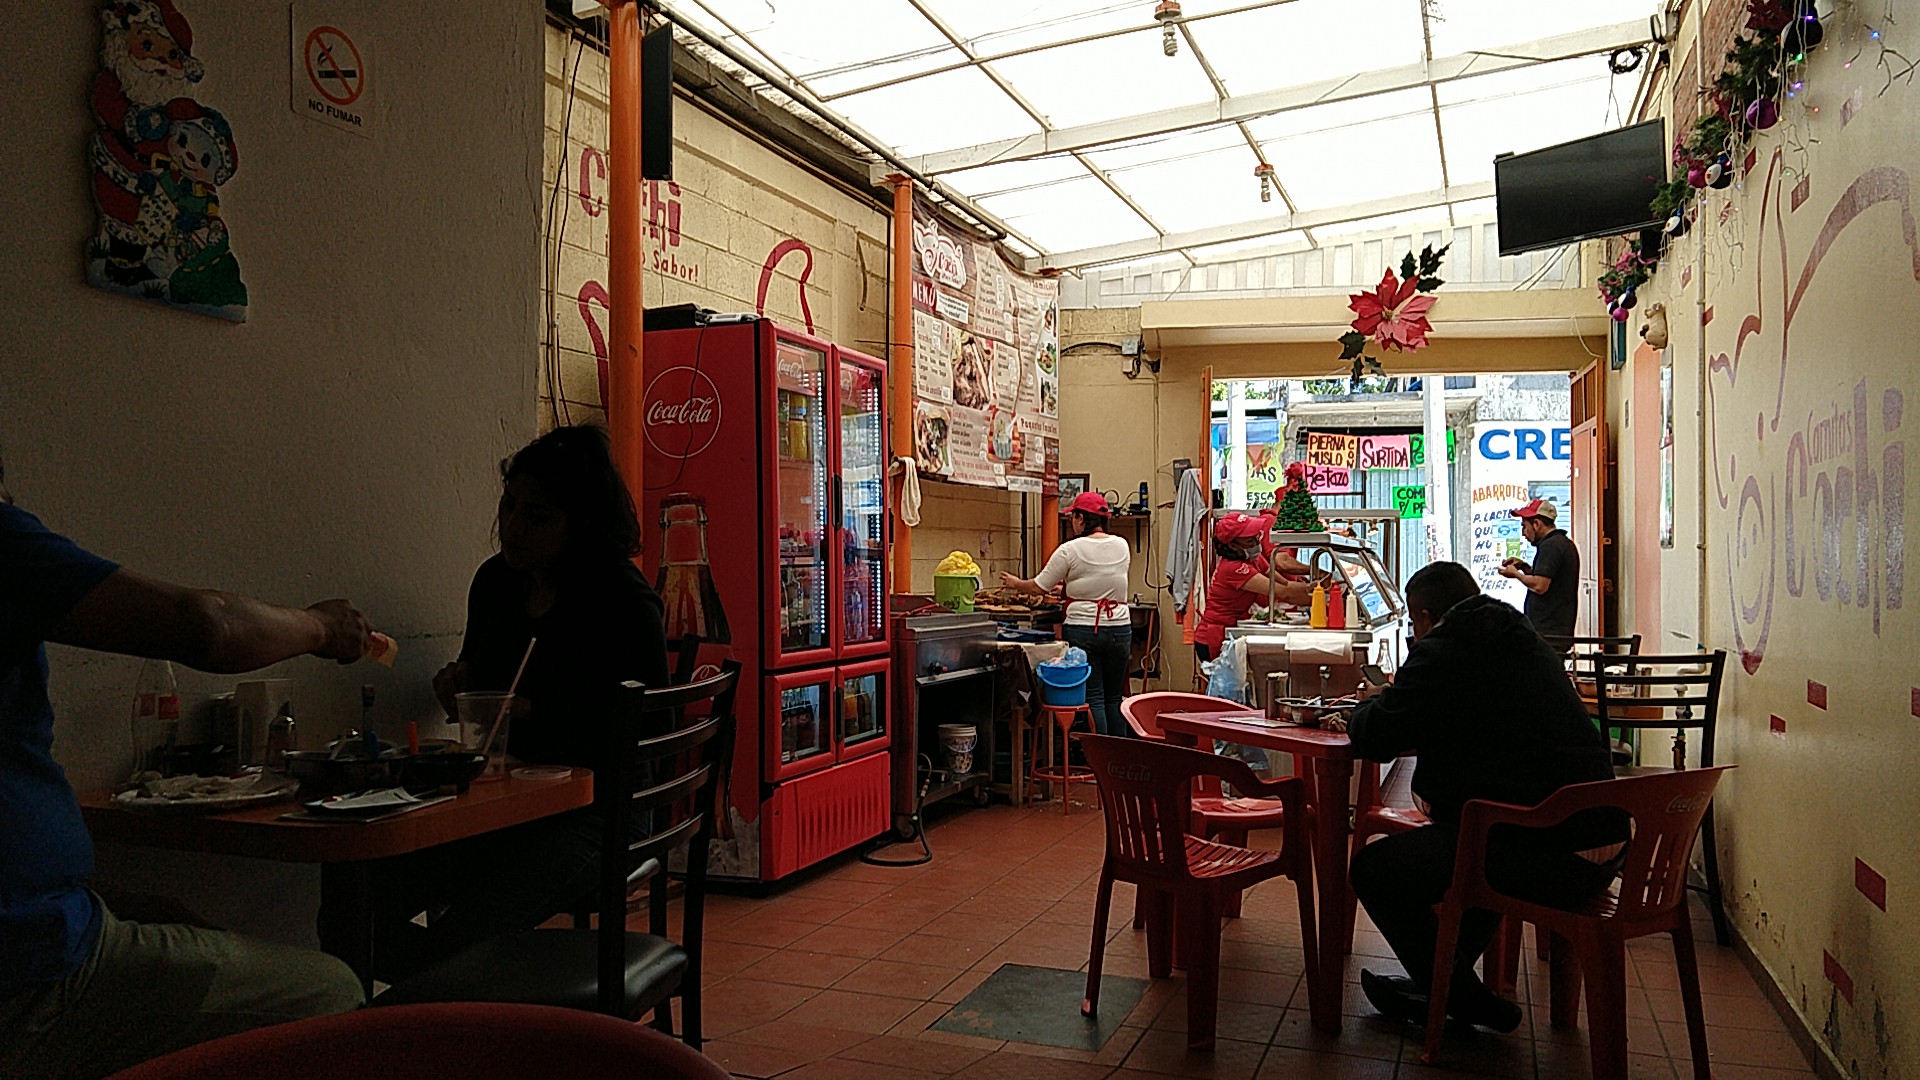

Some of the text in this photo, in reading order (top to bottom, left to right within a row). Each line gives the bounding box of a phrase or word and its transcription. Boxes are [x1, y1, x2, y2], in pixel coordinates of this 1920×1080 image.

[308, 98, 362, 127] NO FUMAR
[579, 147, 682, 252] Chi
[653, 249, 699, 282] Sabor!
[646, 396, 715, 426] Coca-Cola
[1309, 434, 1346, 451] PIERNA
[1479, 428, 1571, 460] CRE
[1806, 400, 1853, 466] Carnitas
[1308, 451, 1343, 466] MUSLO
[1304, 463, 1349, 491] Retazo
[1472, 484, 1528, 504] ABARROTES
